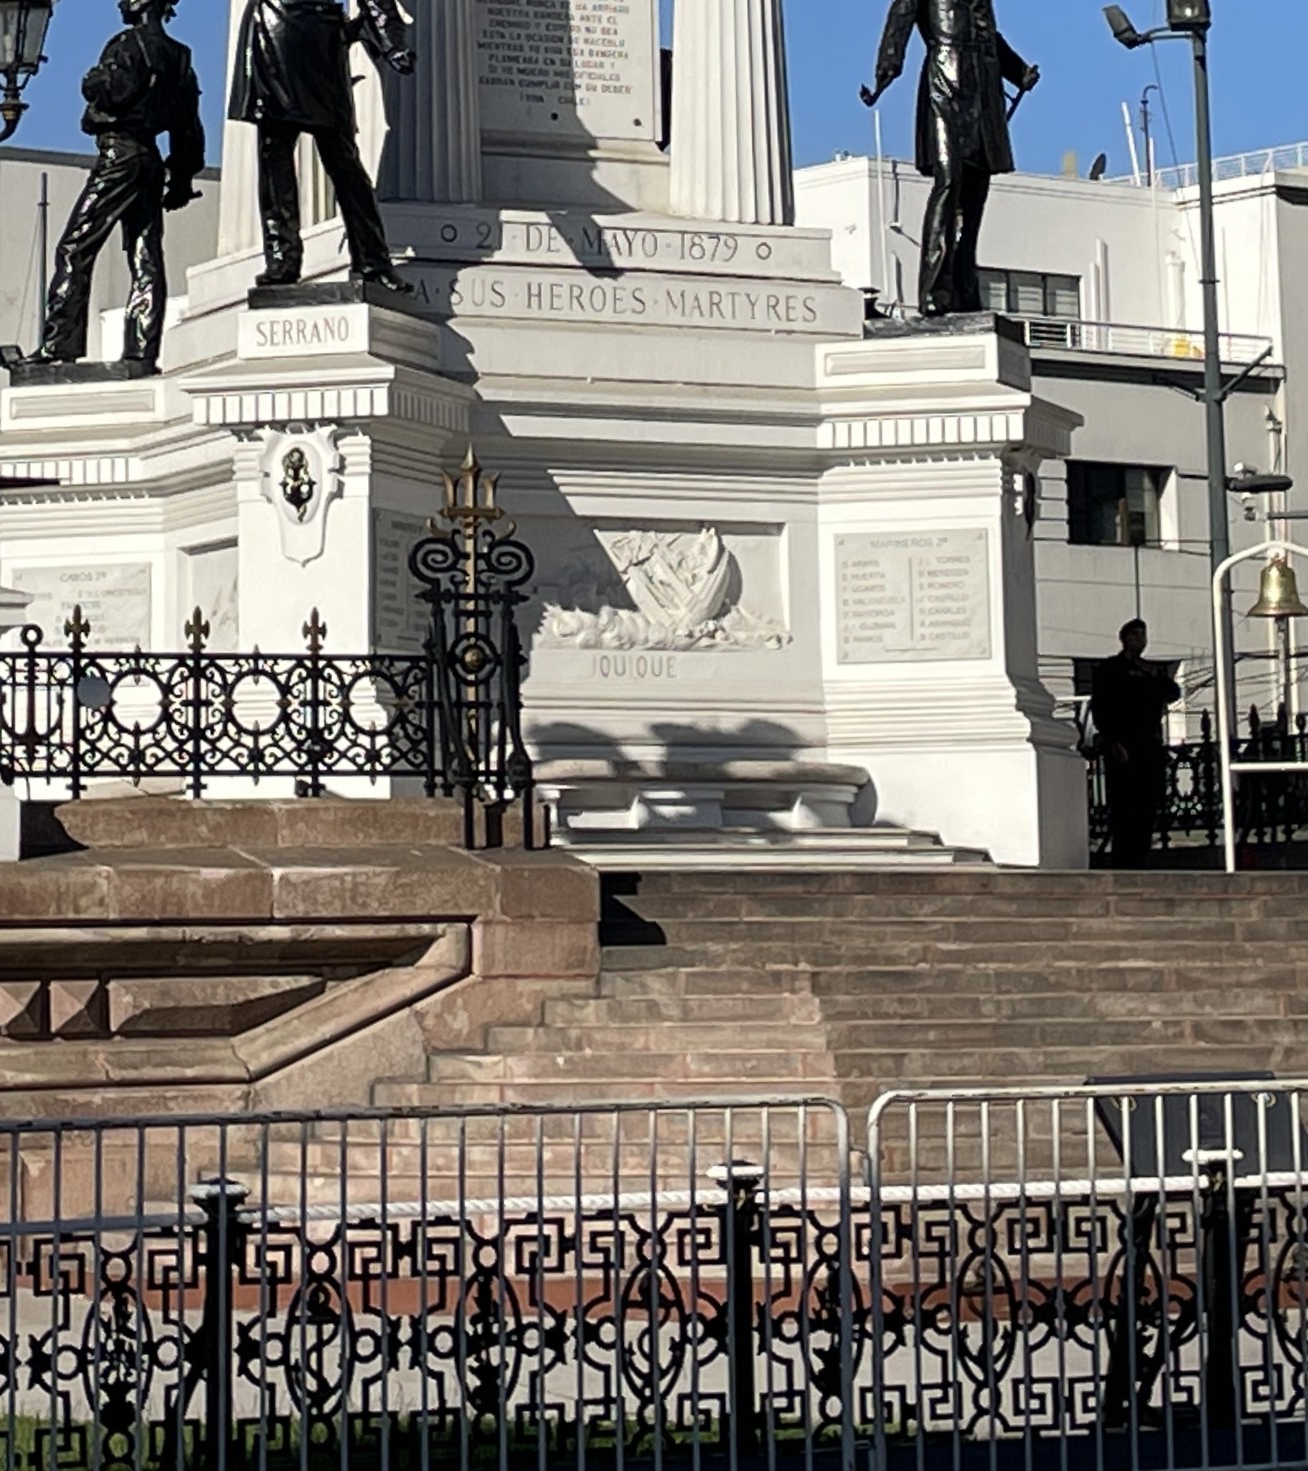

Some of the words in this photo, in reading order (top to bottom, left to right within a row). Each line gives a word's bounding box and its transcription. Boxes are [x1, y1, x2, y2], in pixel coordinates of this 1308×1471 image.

[526, 225, 561, 254] DE
[582, 227, 659, 259] MAYO
[679, 232, 739, 262] 1879
[449, 278, 507, 307] SUS
[527, 282, 647, 316] HEROES
[665, 289, 818, 324] MARTYRES
[256, 316, 350, 347] SERRANO
